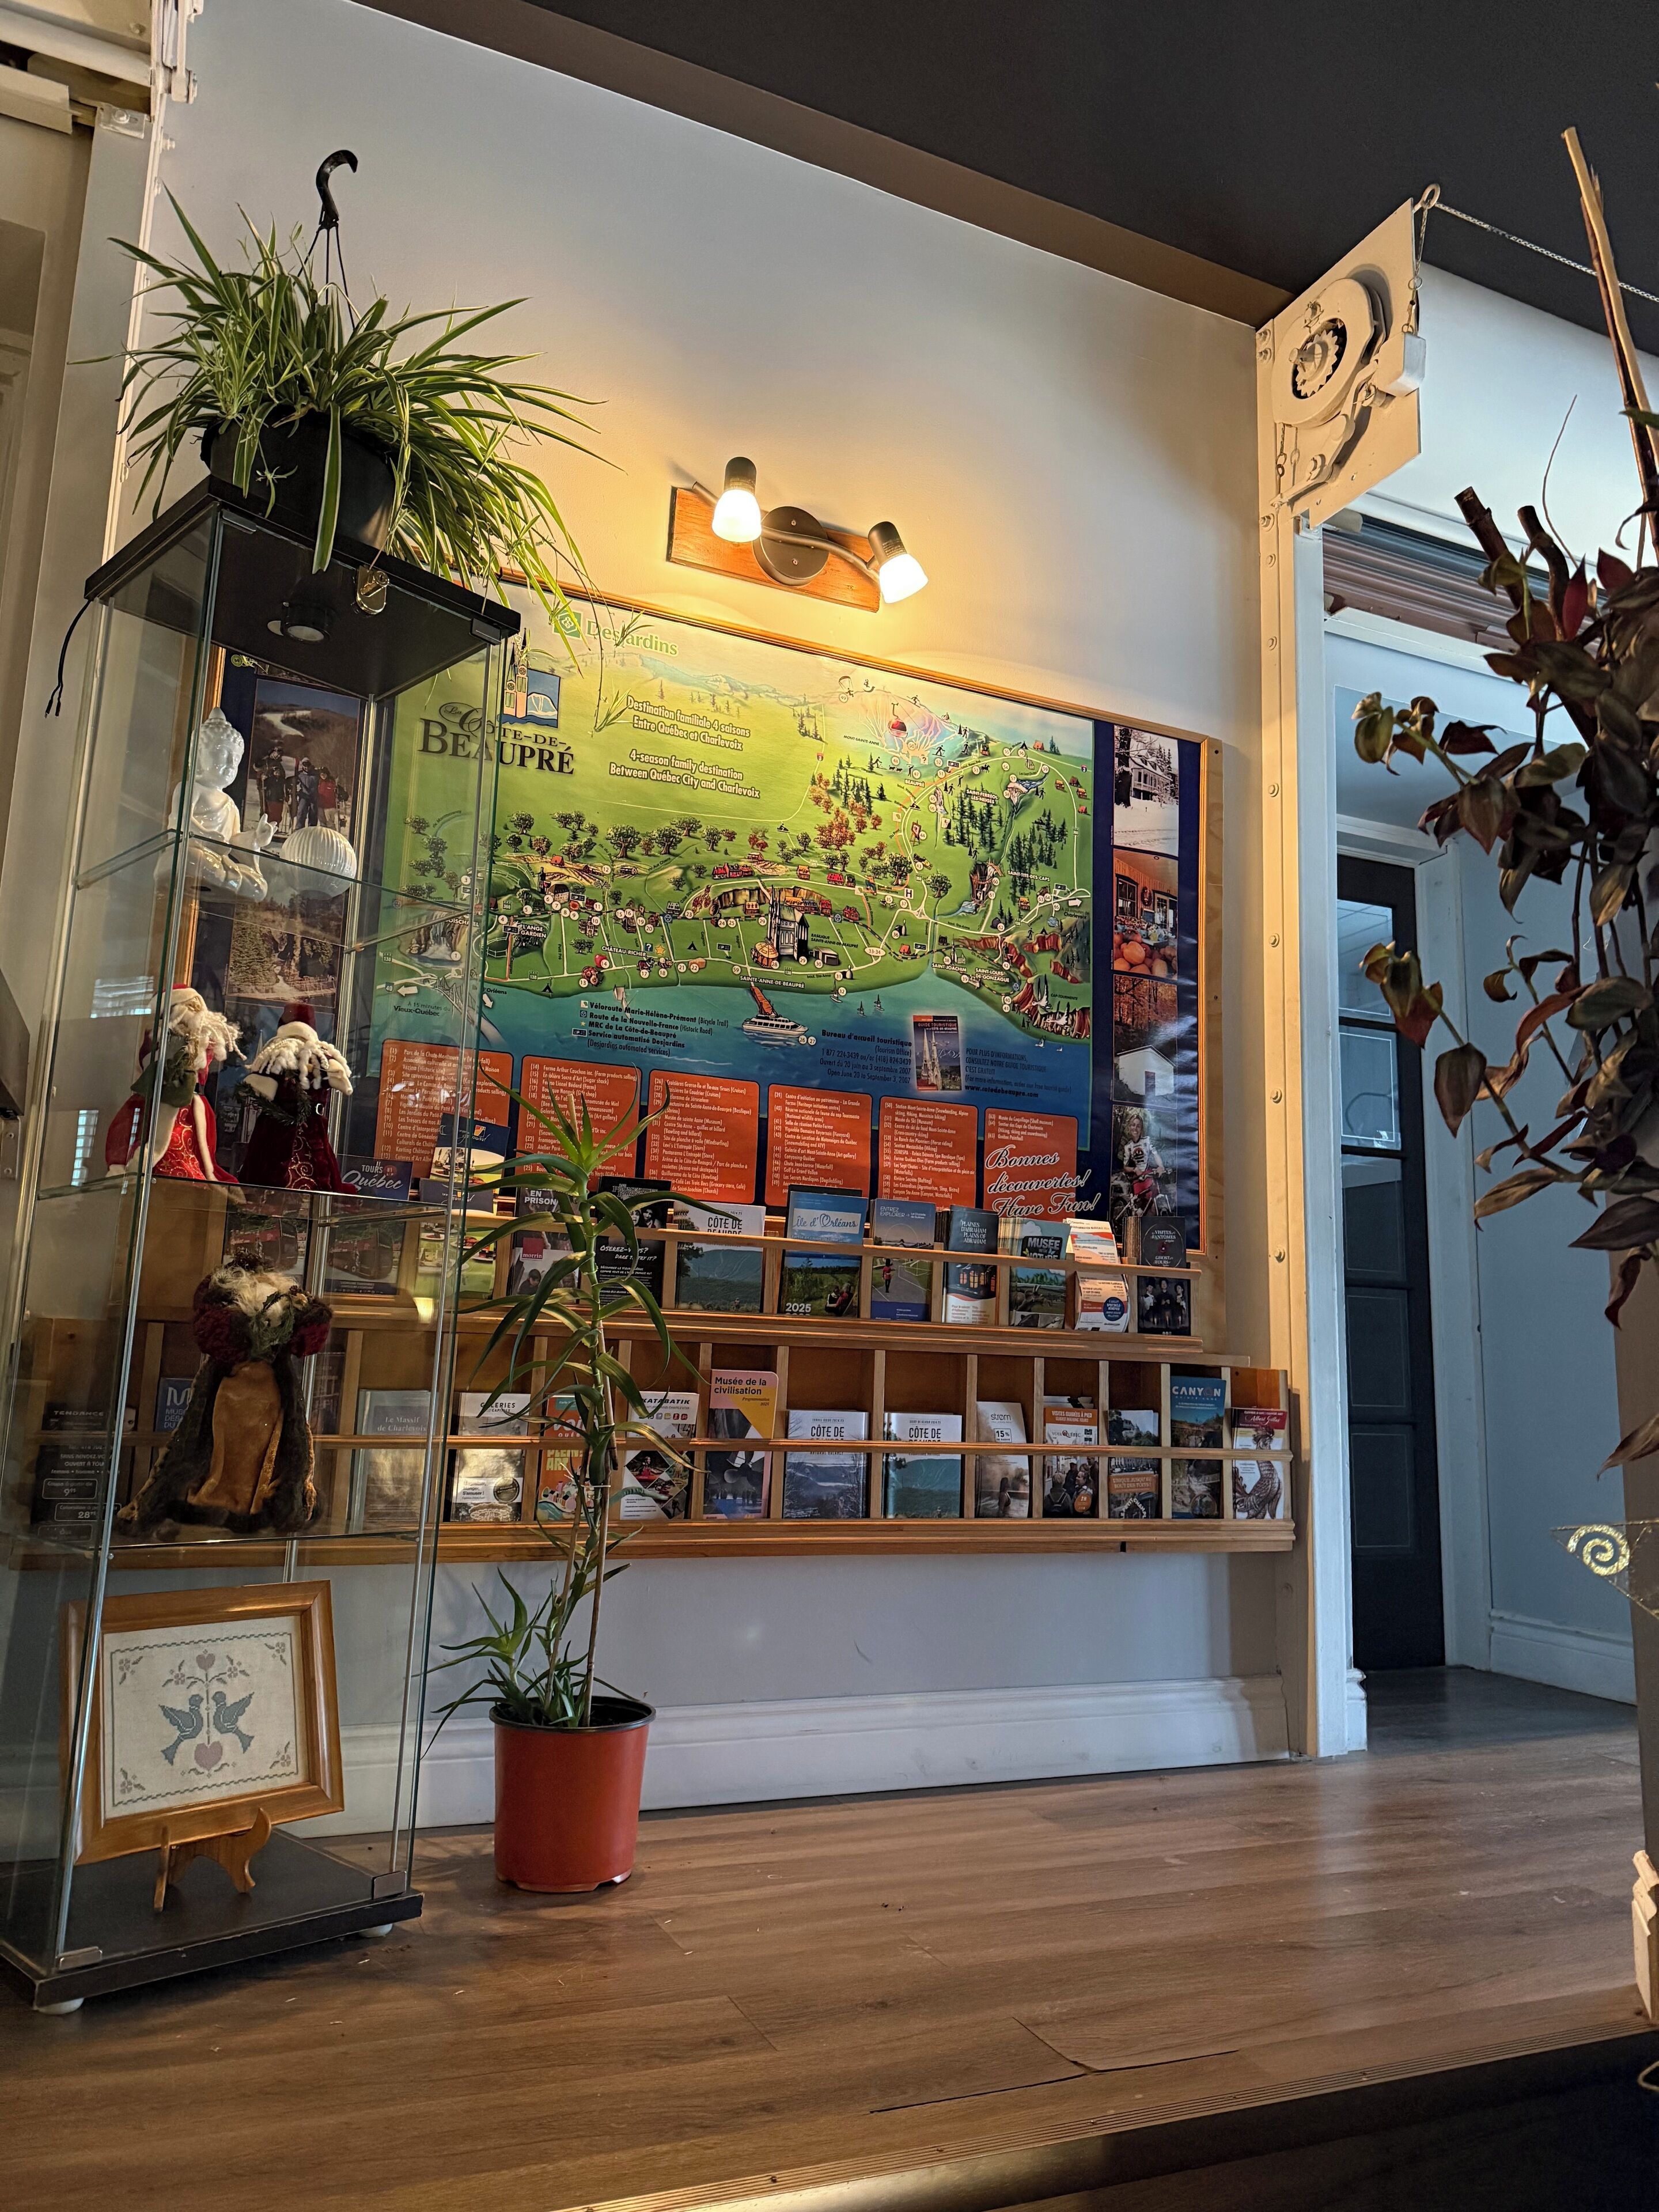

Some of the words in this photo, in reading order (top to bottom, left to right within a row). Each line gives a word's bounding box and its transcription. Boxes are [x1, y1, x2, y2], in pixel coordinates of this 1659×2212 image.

[587, 620, 678, 656] Desardins
[444, 705, 463, 715] La
[627, 695, 675, 720] Destination
[676, 710, 711, 729] familiale
[712, 720, 719, 730] 4
[720, 724, 750, 737] saisons
[632, 716, 656, 731] Entre
[657, 722, 688, 740] Québec
[689, 731, 698, 740] et
[700, 732, 743, 751] Charlevoix
[418, 718, 574, 775] BEAUPRÉ
[630, 749, 669, 766] 4-season
[671, 756, 696, 773] family
[698, 763, 743, 781] destination
[609, 762, 647, 779] Between
[650, 768, 680, 784] Québec
[682, 774, 699, 790] City
[700, 779, 716, 790] and
[717, 781, 760, 798] Charlevoix
[521, 930, 547, 939] GARDIEN
[522, 924, 546, 932] L'ANGE-
[601, 945, 647, 958] CHÂTEAU-RICHER
[932, 963, 967, 972] SAINT-JOACHIM
[590, 1002, 623, 1013] Véloroute
[624, 1007, 696, 1022] Marie-Hélène-Prémont
[588, 1021, 603, 1029] MRC
[605, 1022, 613, 1030] de
[625, 1025, 677, 1039] Côte-de-Beaupré
[589, 1012, 609, 1021] Route
[629, 1018, 679, 1031] Nouvelle-France
[699, 1027, 713, 1036] Road)
[588, 1030, 612, 1039] Service
[613, 1033, 650, 1044] automatisé
[652, 1038, 685, 1048] Desjardins
[821, 1029, 846, 1039] Bureau
[847, 1032, 875, 1043] d'accueil
[877, 1037, 912, 1047] touristique
[619, 1043, 647, 1053] automated
[826, 1049, 835, 1057] 877
[985, 1145, 1060, 1169] Bonnes
[362, 1162, 383, 1174] TOURS
[342, 1170, 403, 1191] Québec
[987, 1169, 1092, 1194] découvertes!
[524, 1197, 556, 1205] PRISON
[993, 1195, 1044, 1217] Have
[1047, 1192, 1101, 1214] Fun!
[708, 1216, 729, 1229] CÔTE
[732, 1219, 743, 1230] DE
[793, 1215, 807, 1227] Île
[809, 1213, 858, 1229] d'Orléans
[600, 1245, 649, 1254] OSEREZ-VS?
[1027, 1237, 1060, 1249] MUSÉE
[785, 1303, 812, 1313] 2025
[715, 1377, 743, 1385] Musée
[746, 1377, 757, 1385] de
[714, 1387, 762, 1395] civilisation
[1172, 1386, 1221, 1397] CANYON
[810, 1425, 831, 1437] CÔTE
[834, 1427, 844, 1437] DE
[909, 1426, 929, 1438] CÔTE
[931, 1429, 941, 1438] DE
